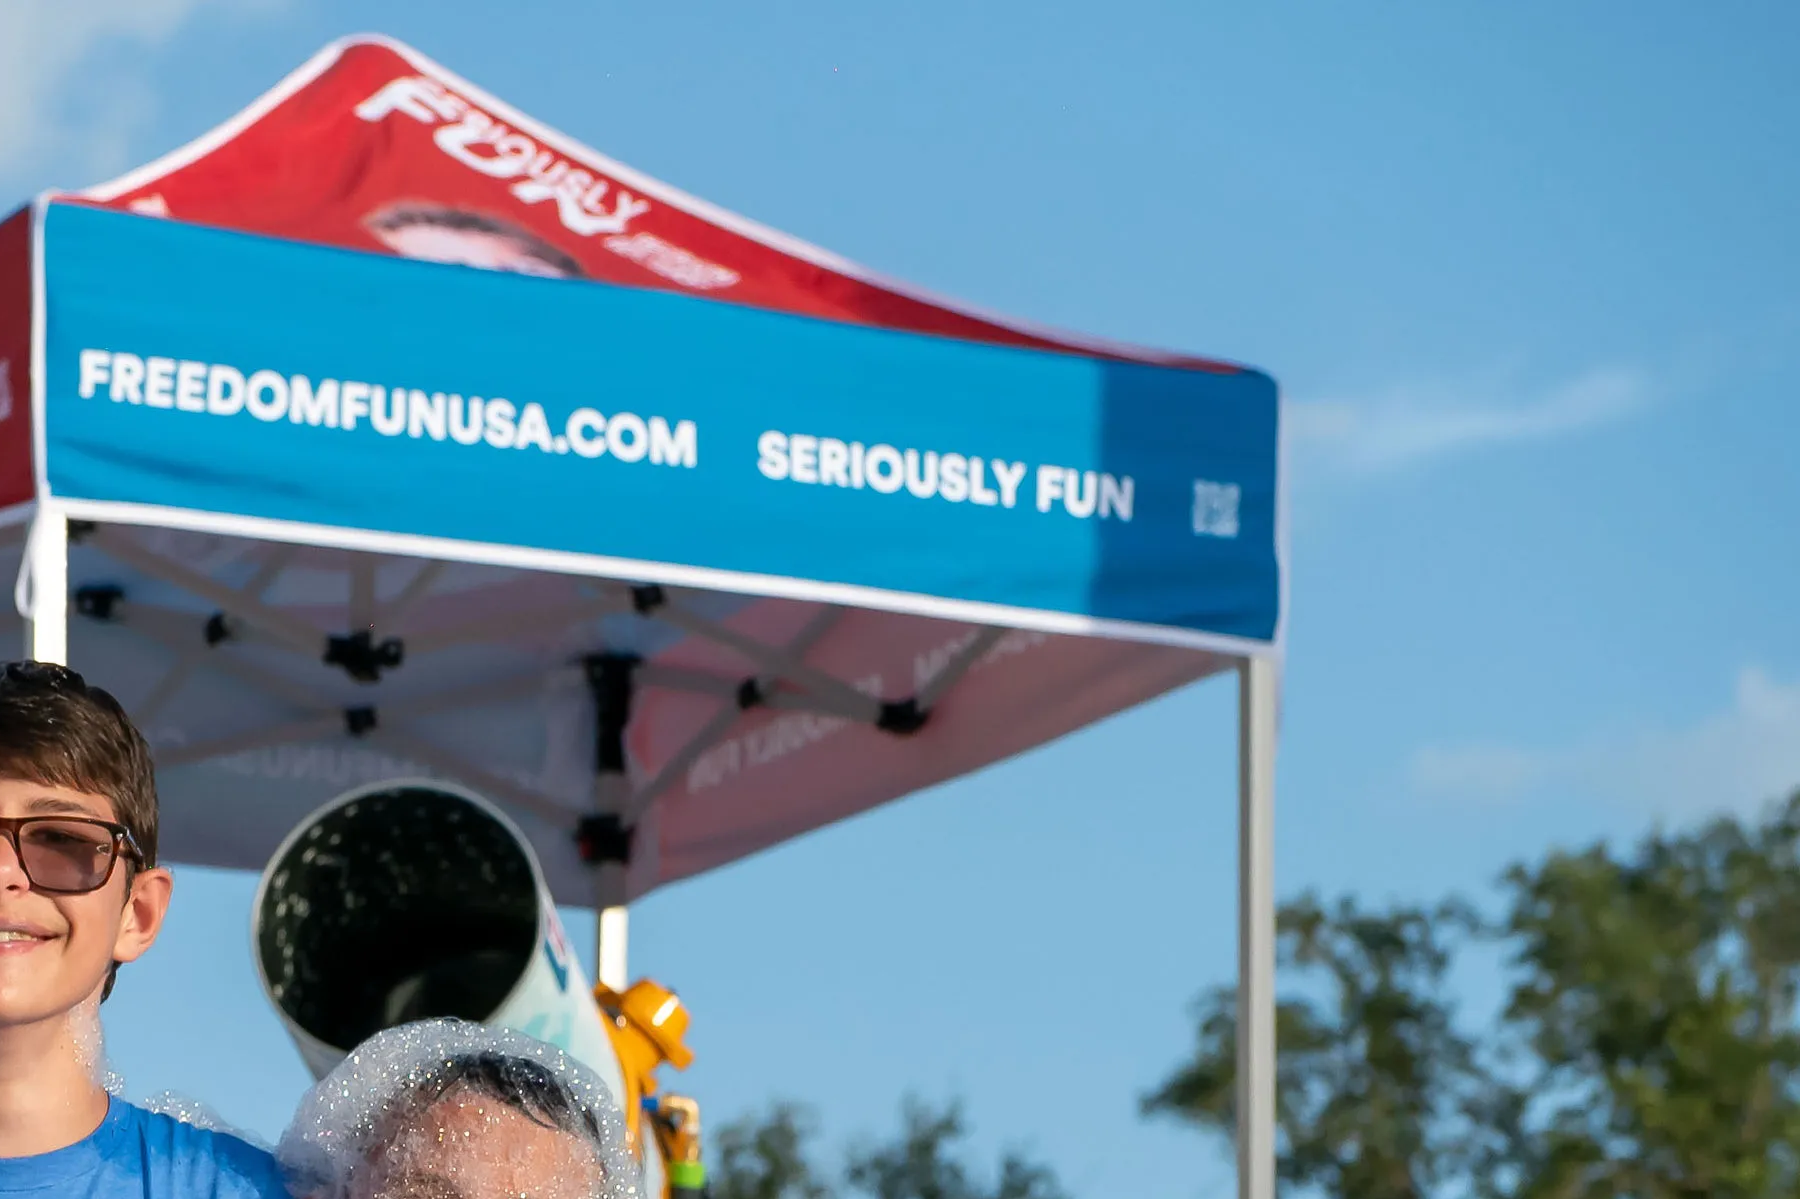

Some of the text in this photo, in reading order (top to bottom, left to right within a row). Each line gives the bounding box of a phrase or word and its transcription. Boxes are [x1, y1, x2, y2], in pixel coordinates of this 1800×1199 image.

[78, 348, 1134, 522] FREEDOMFUNUSA.COM SERIOUSLY FUN
